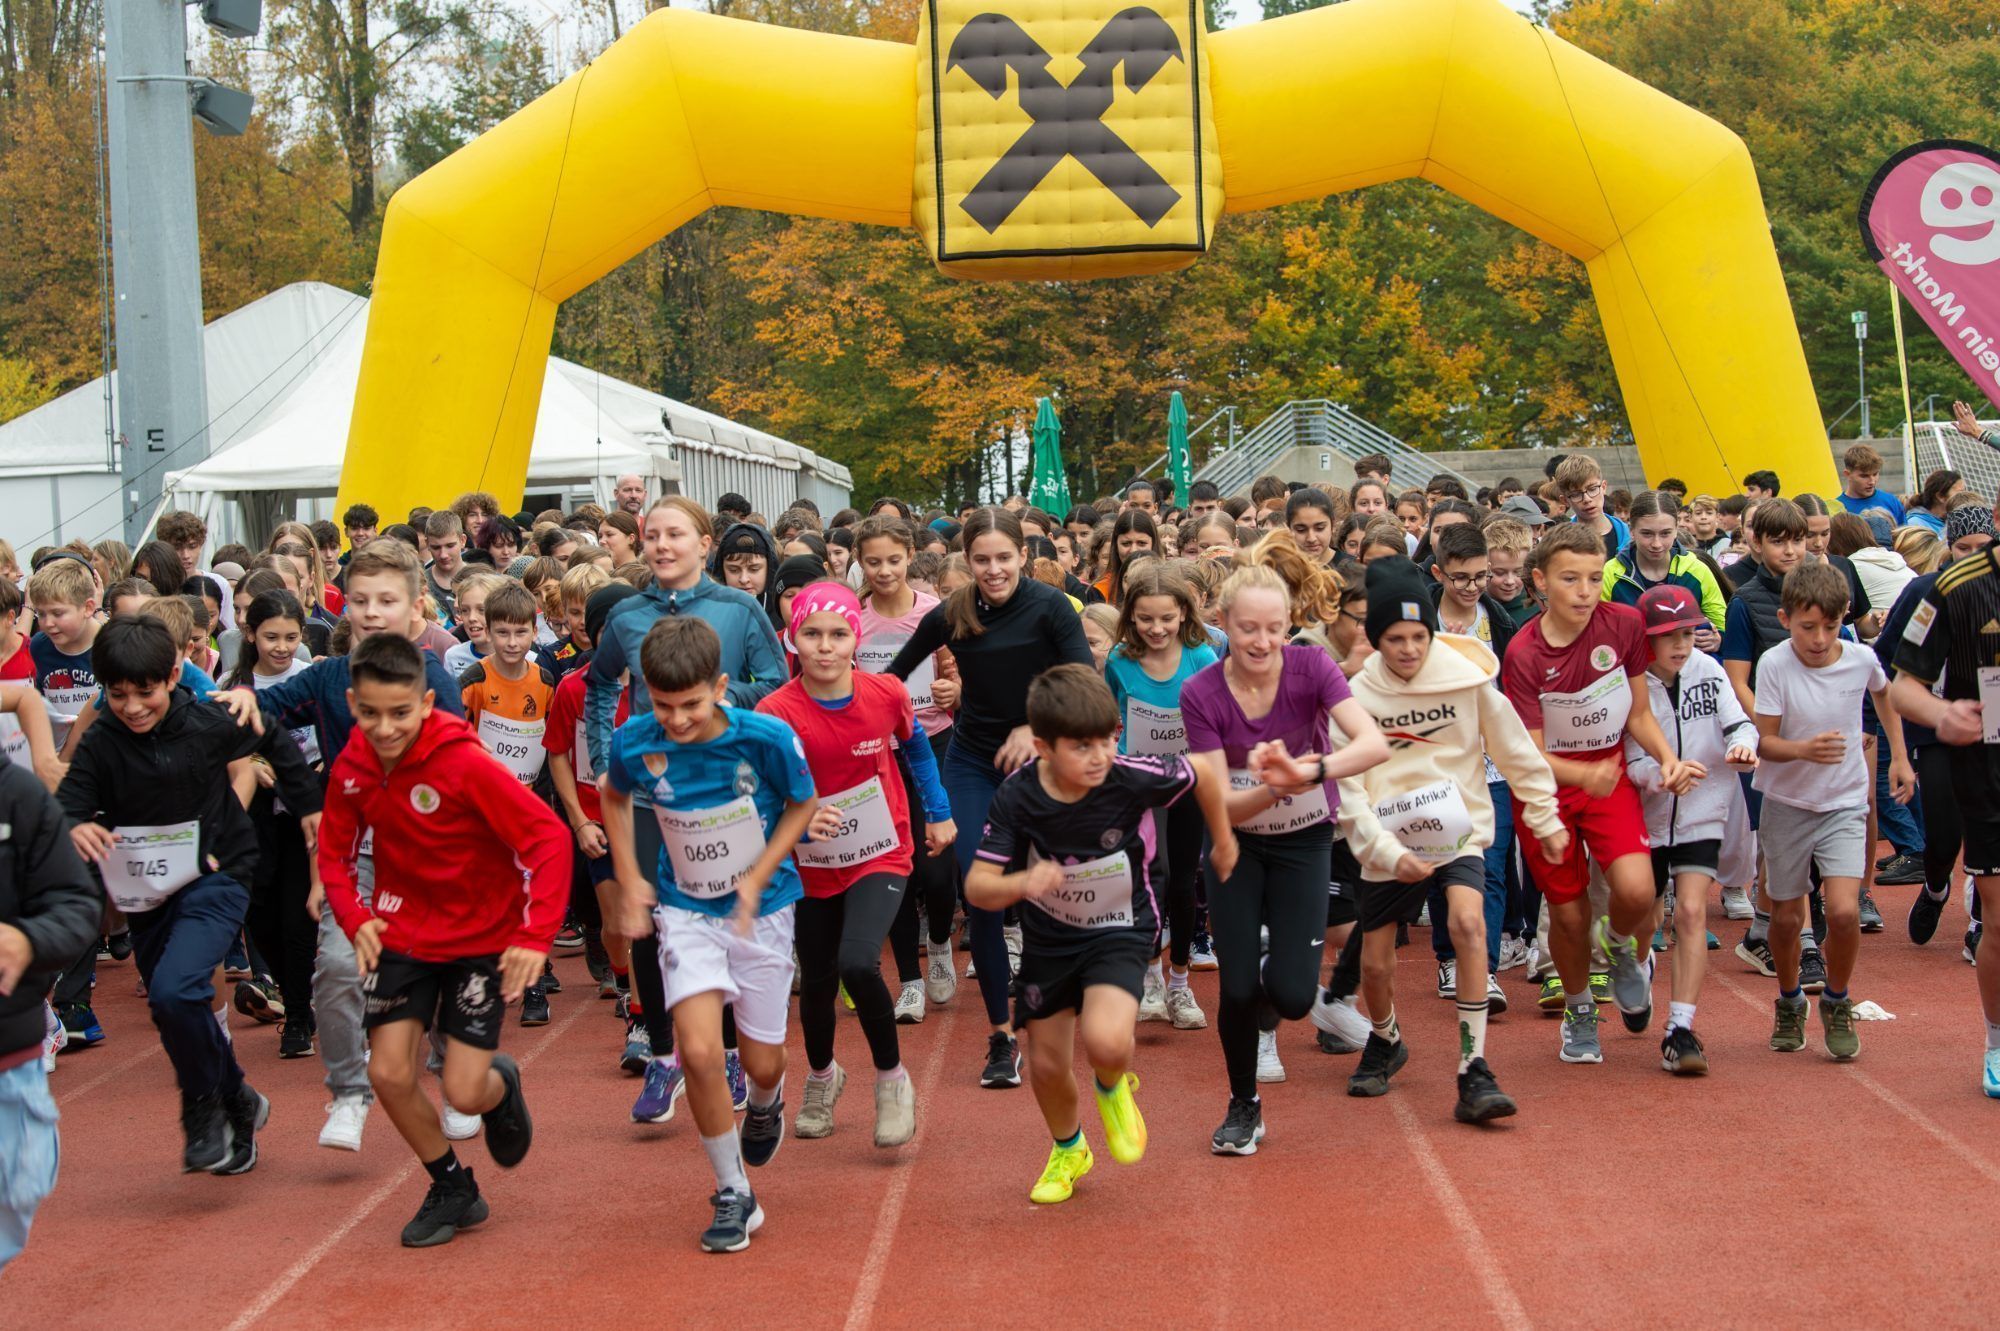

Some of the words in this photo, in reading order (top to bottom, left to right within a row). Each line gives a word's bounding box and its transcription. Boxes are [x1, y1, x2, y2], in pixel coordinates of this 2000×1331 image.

[147, 429, 165, 452] E
[1321, 454, 1329, 469] F
[911, 695, 932, 706] frika
[1571, 707, 1608, 728] 0689
[1150, 727, 1184, 741] 0483
[496, 742, 529, 759] 0929
[858, 737, 882, 750] SMS
[1587, 739, 1602, 748] für
[1396, 799, 1412, 813] für
[1268, 822, 1287, 832] für
[1290, 809, 1324, 828] Afrika
[1398, 817, 1444, 836] 1548
[684, 840, 730, 862] 0683
[838, 852, 856, 864] für
[859, 838, 892, 859] Afrika
[127, 859, 169, 877] 0745
[708, 878, 728, 893] für
[1086, 910, 1126, 926] Afrika
